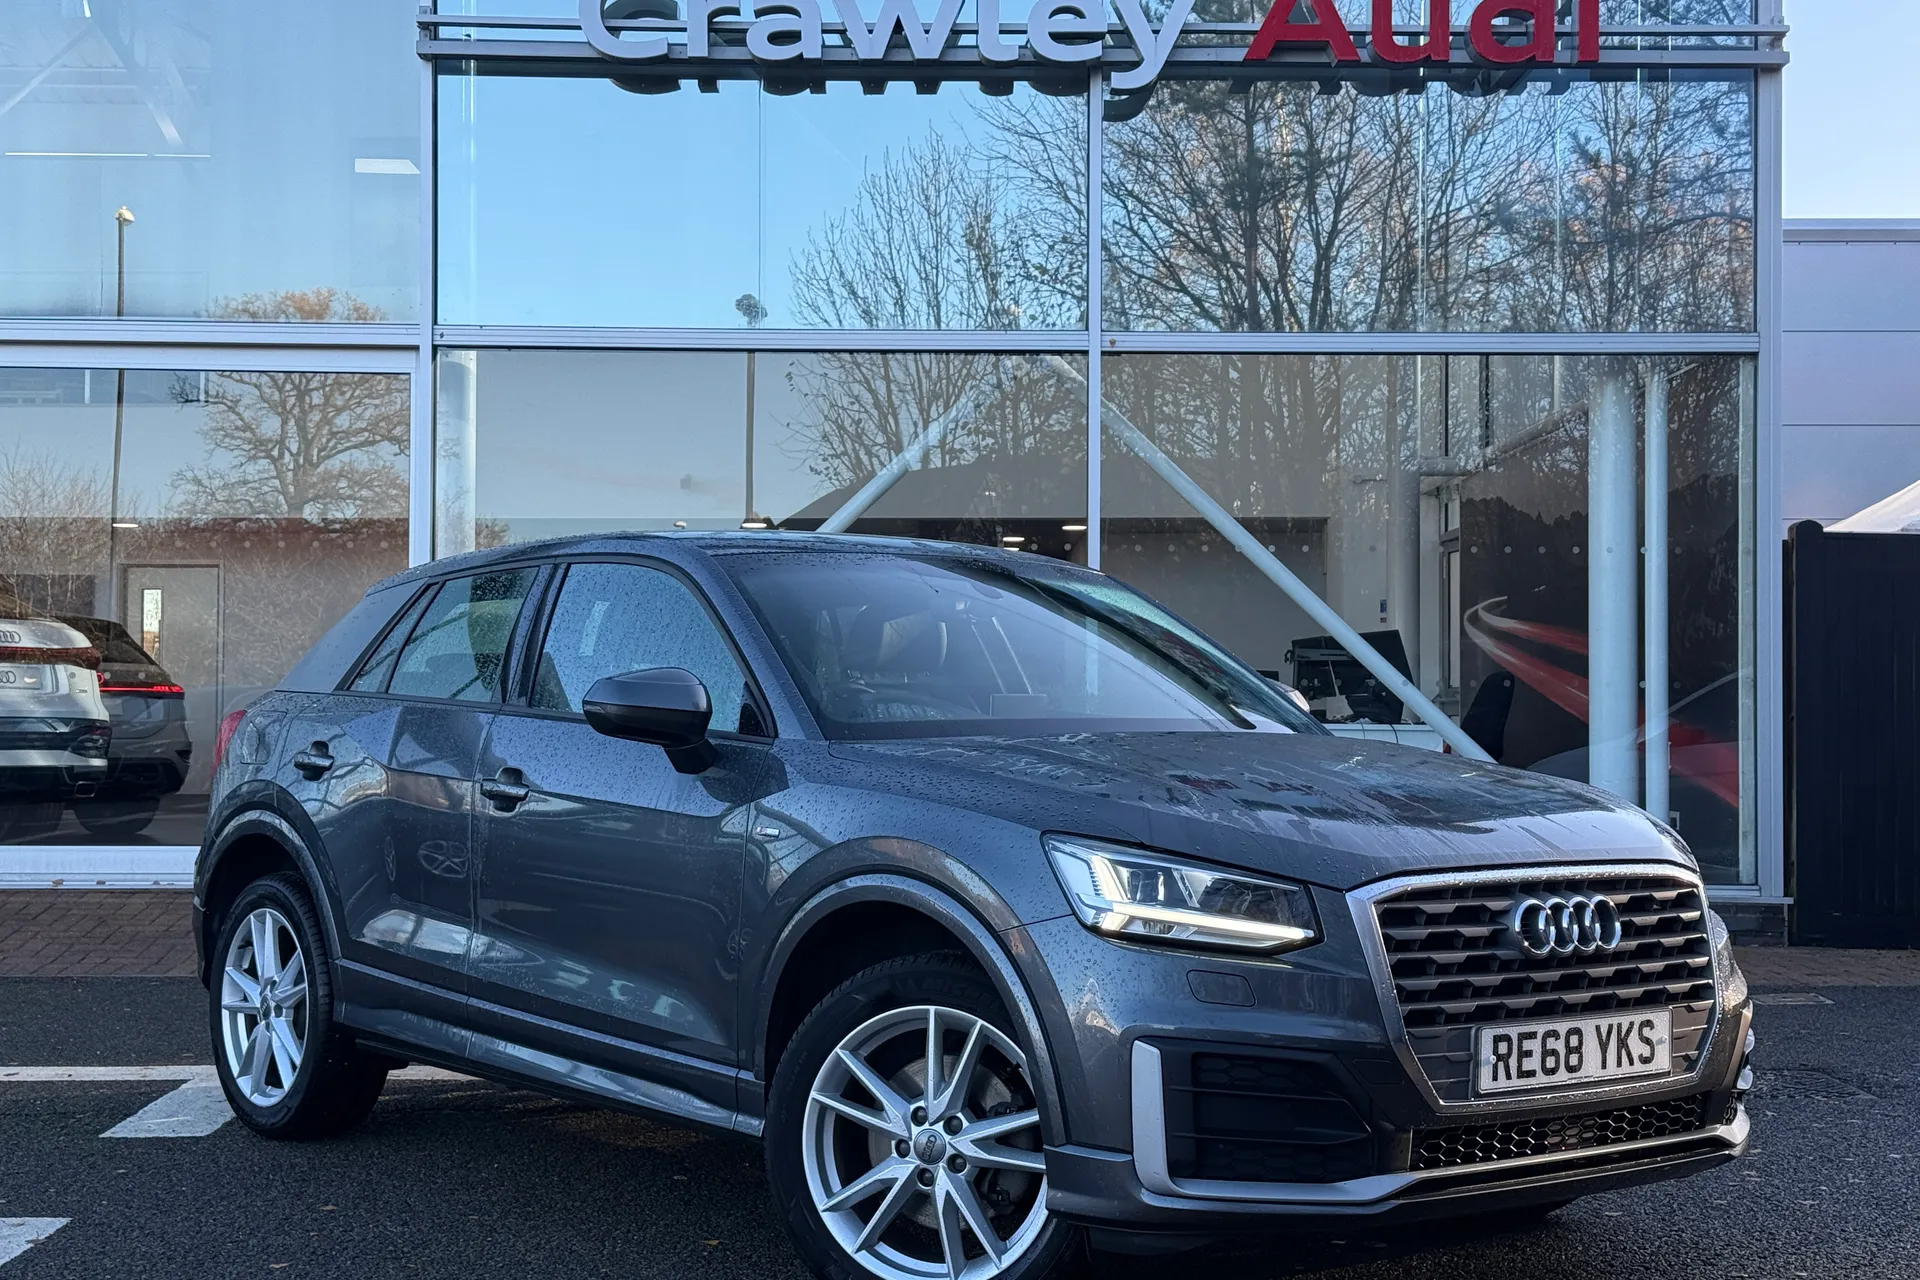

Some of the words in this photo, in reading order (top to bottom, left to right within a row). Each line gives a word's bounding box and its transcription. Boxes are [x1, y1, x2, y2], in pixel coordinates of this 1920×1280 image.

[578, 0, 1196, 89] Crawley
[1491, 1026, 1585, 1082] RE68
[1595, 1018, 1656, 1071] YKS
